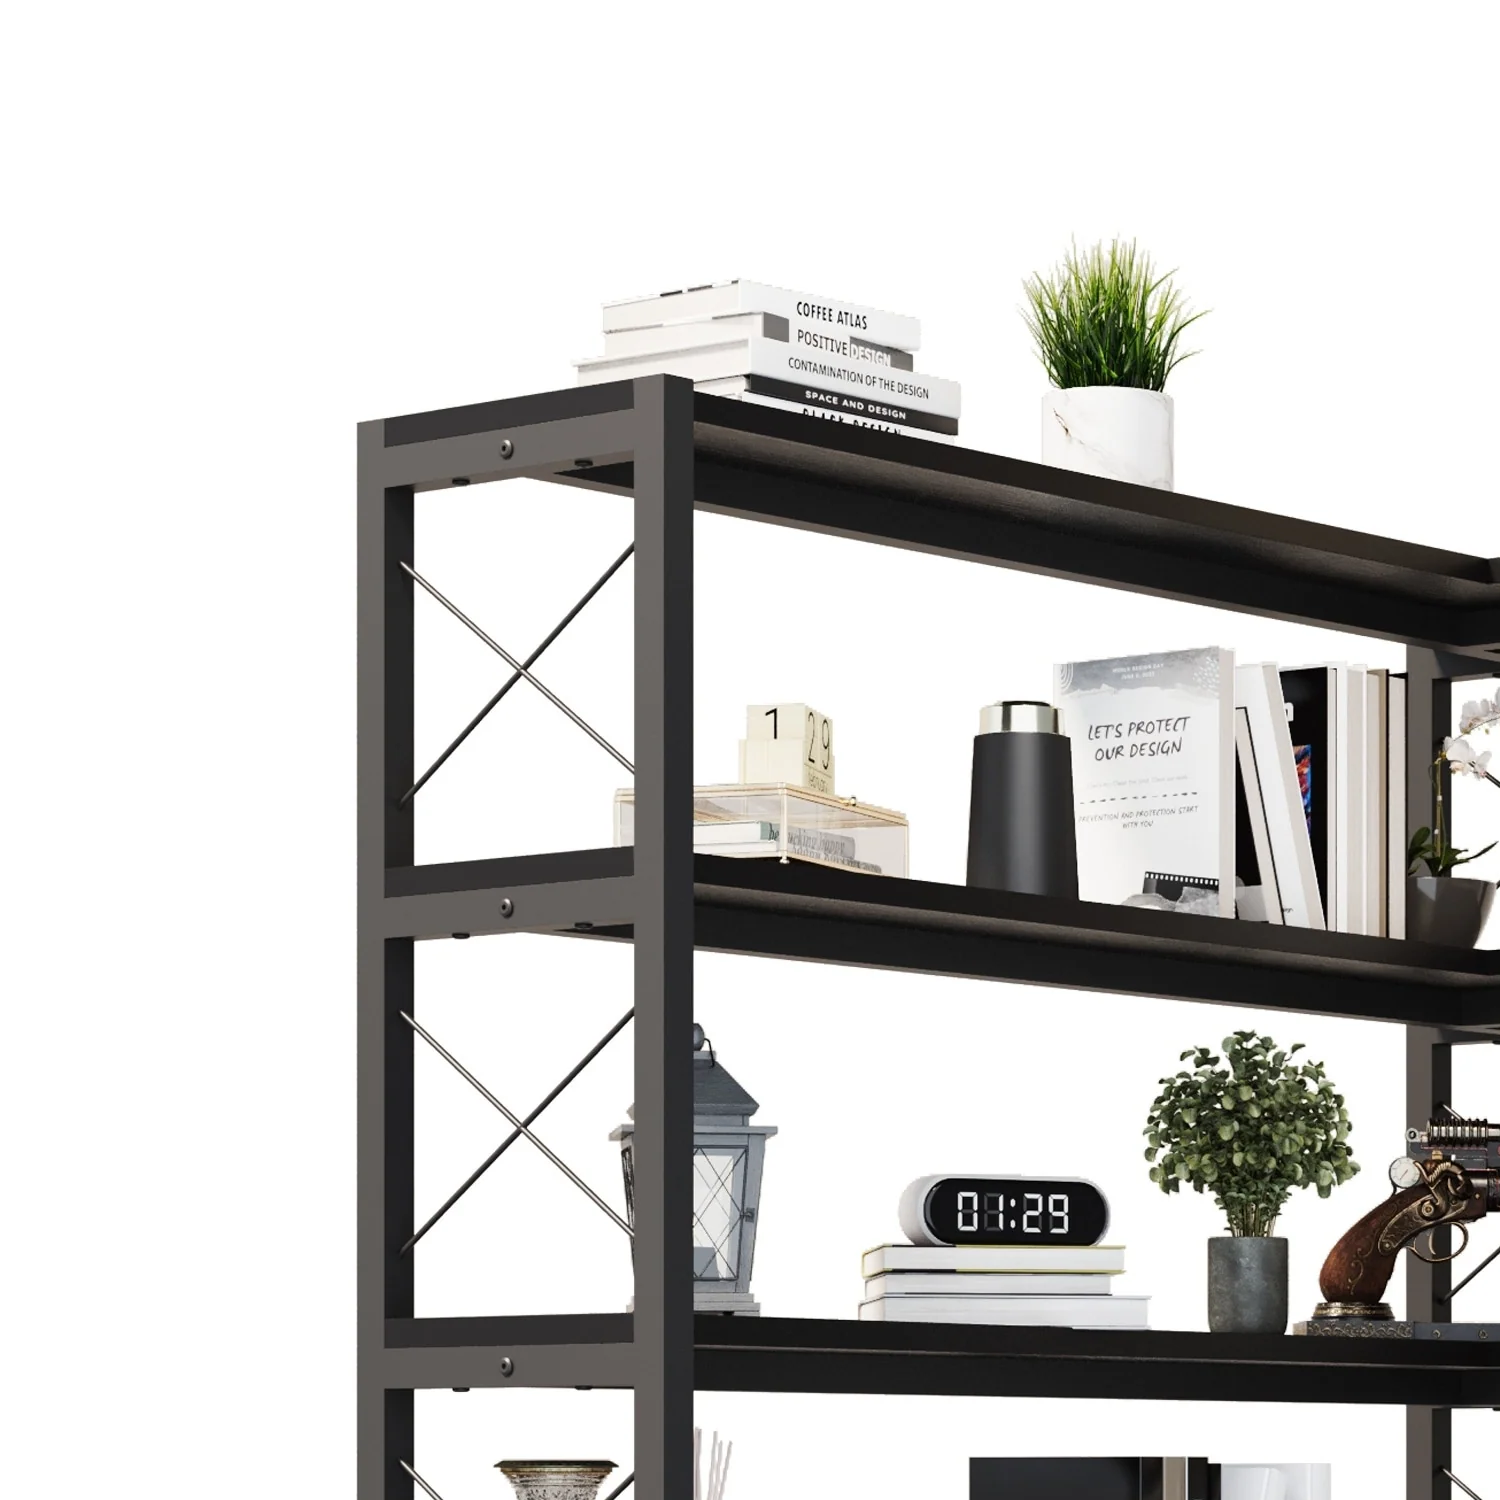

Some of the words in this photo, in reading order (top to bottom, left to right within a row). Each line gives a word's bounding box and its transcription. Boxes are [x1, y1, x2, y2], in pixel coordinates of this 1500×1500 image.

[796, 301, 833, 323] COFFEE
[836, 310, 868, 330] ATLAS
[798, 329, 847, 355] POSITIVE
[849, 343, 892, 367] DESIGN
[788, 356, 864, 385] CONTAMINATION
[865, 374, 877, 387] OF
[878, 377, 896, 392] THE
[897, 381, 929, 400] DESIGN
[805, 390, 839, 405] SPACE
[841, 398, 865, 411] AND
[867, 404, 907, 421] DESIGN
[765, 707, 778, 739] 1
[1128, 716, 1191, 737] PROTECT
[1095, 745, 1125, 761] OUR
[1130, 737, 1183, 758] DESIGN
[957, 1191, 1069, 1234] 01:29
